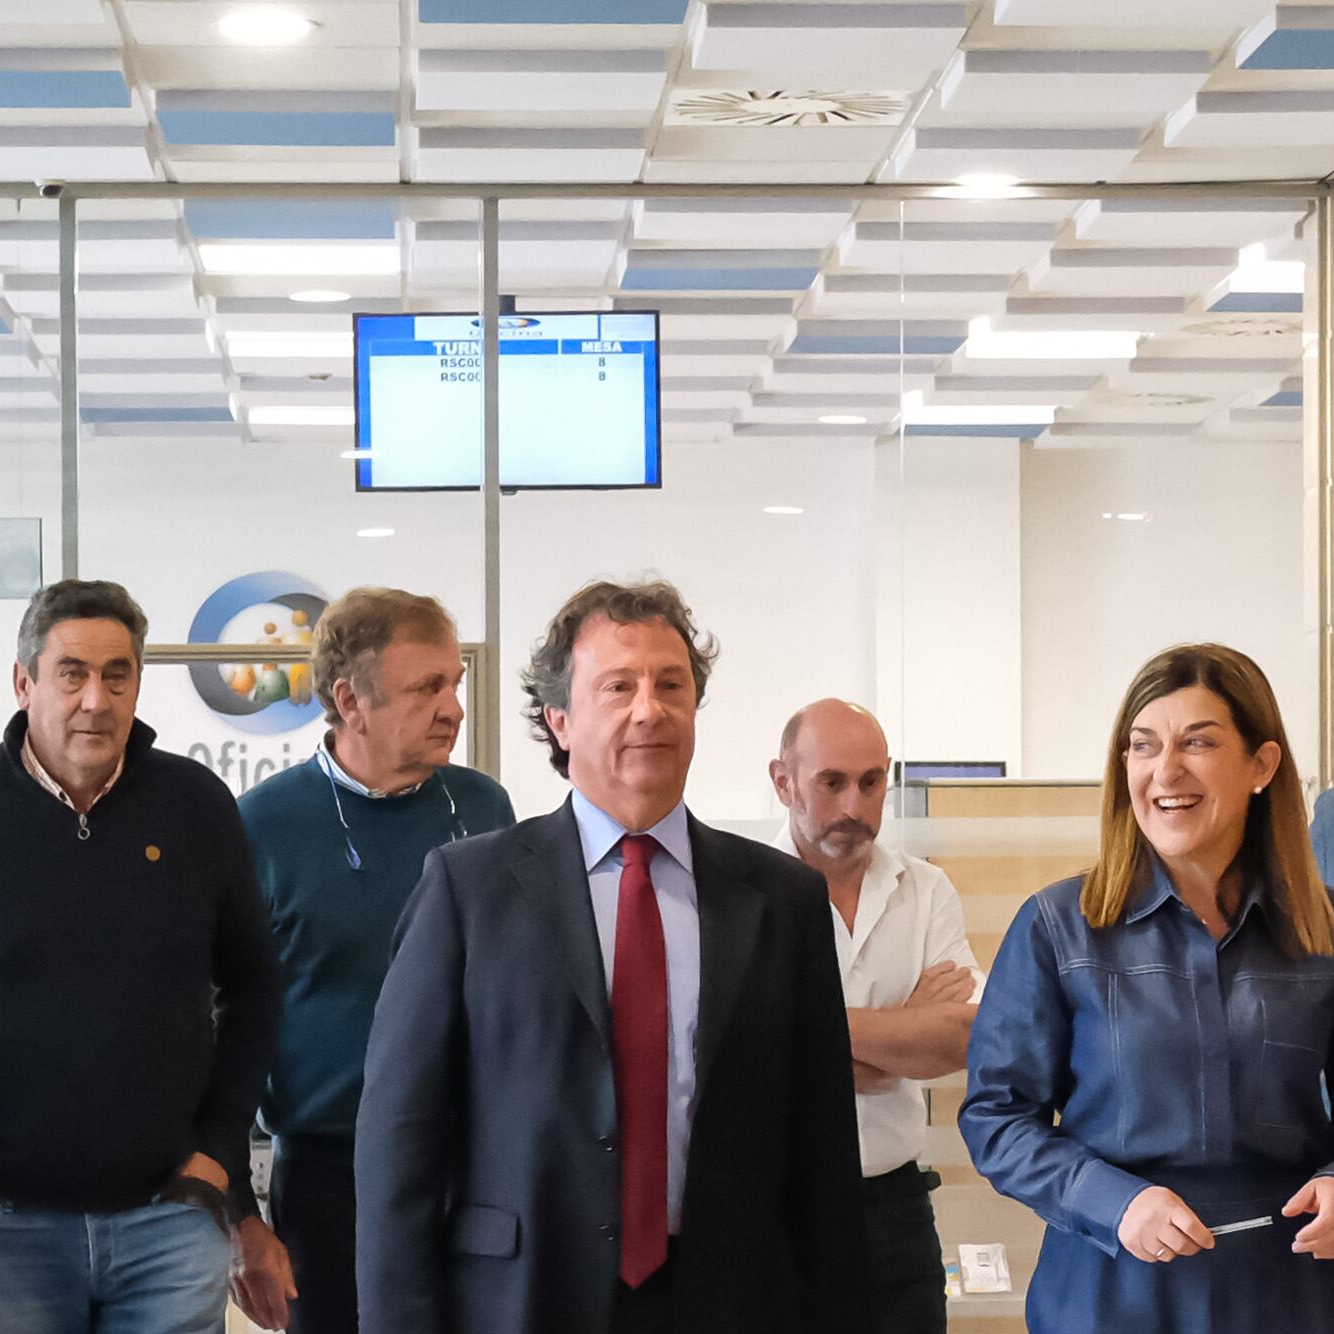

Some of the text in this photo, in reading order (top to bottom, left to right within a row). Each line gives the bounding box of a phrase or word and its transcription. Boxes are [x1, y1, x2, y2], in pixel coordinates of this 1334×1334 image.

[433, 342, 480, 355] TURN
[581, 341, 622, 352] MESA
[440, 358, 480, 368] RSC00
[440, 372, 480, 382] RSC00
